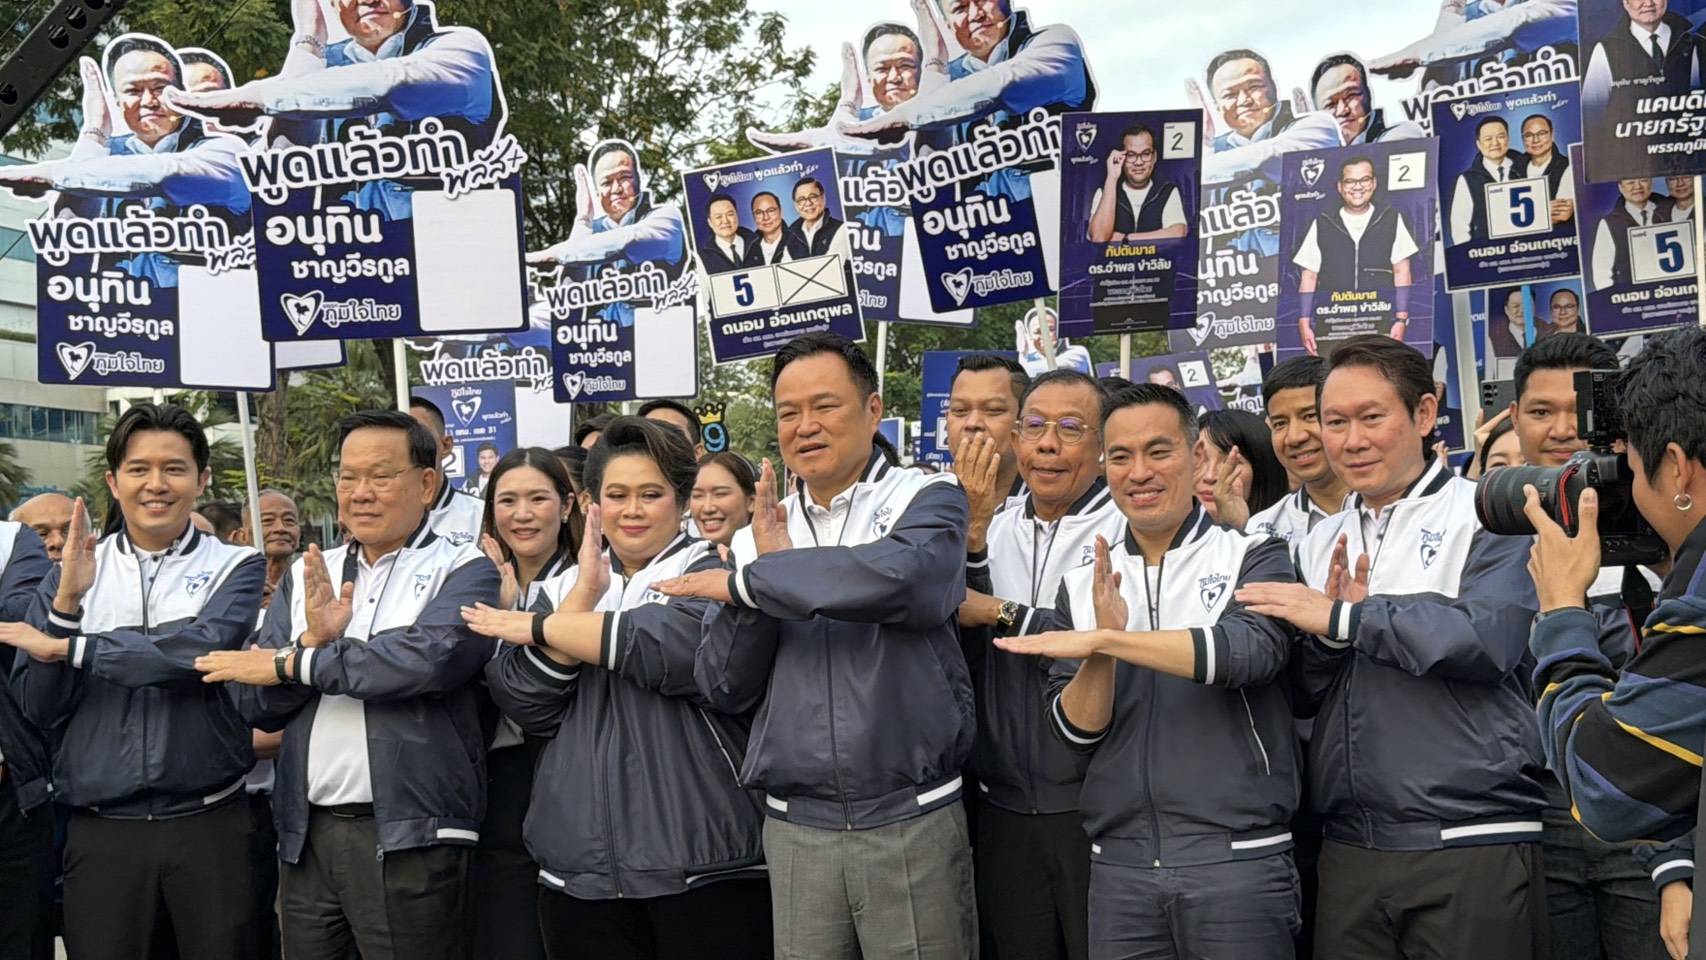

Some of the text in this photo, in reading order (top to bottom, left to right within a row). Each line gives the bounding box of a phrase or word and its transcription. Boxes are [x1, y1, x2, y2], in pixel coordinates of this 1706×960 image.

[1615, 112, 1706, 138] นายกรัฐ
[1171, 132, 1183, 151] 2
[241, 120, 466, 199] พูดแล้วทำ
[754, 161, 803, 181] พูดแล้วทำ
[1397, 165, 1412, 183] 2
[922, 194, 1011, 239] อนุทิน
[1508, 186, 1535, 228] 5
[29, 208, 226, 261] พูดแล้วทำ
[266, 206, 383, 256] อนุทิน
[945, 230, 1036, 260] ชาญวีรกูล
[1468, 244, 1506, 259] ถนอม
[1654, 230, 1685, 273] 5
[291, 253, 410, 283] ชาญวีรกูล
[974, 269, 1034, 296] ภูมิใจไทย
[47, 271, 152, 313] อนุทิน
[547, 263, 666, 315] พูดแล้วทำ
[732, 273, 755, 307] 5
[1611, 290, 1650, 304] ถนอม
[68, 312, 174, 341] ชาญวีรกูล
[323, 299, 402, 327] ภูมิใจไทย
[721, 318, 765, 336] ถนอม
[769, 302, 853, 327] อ่อนเกตุพล
[1214, 314, 1275, 338] ภูมิใจไทย
[557, 319, 618, 350] อนุทิน
[94, 351, 165, 376] ภูมิใจไทย
[569, 347, 632, 368] ชาญวีรกูล
[1187, 368, 1198, 382] 2
[703, 423, 726, 453] 9
[443, 452, 456, 473] 2
